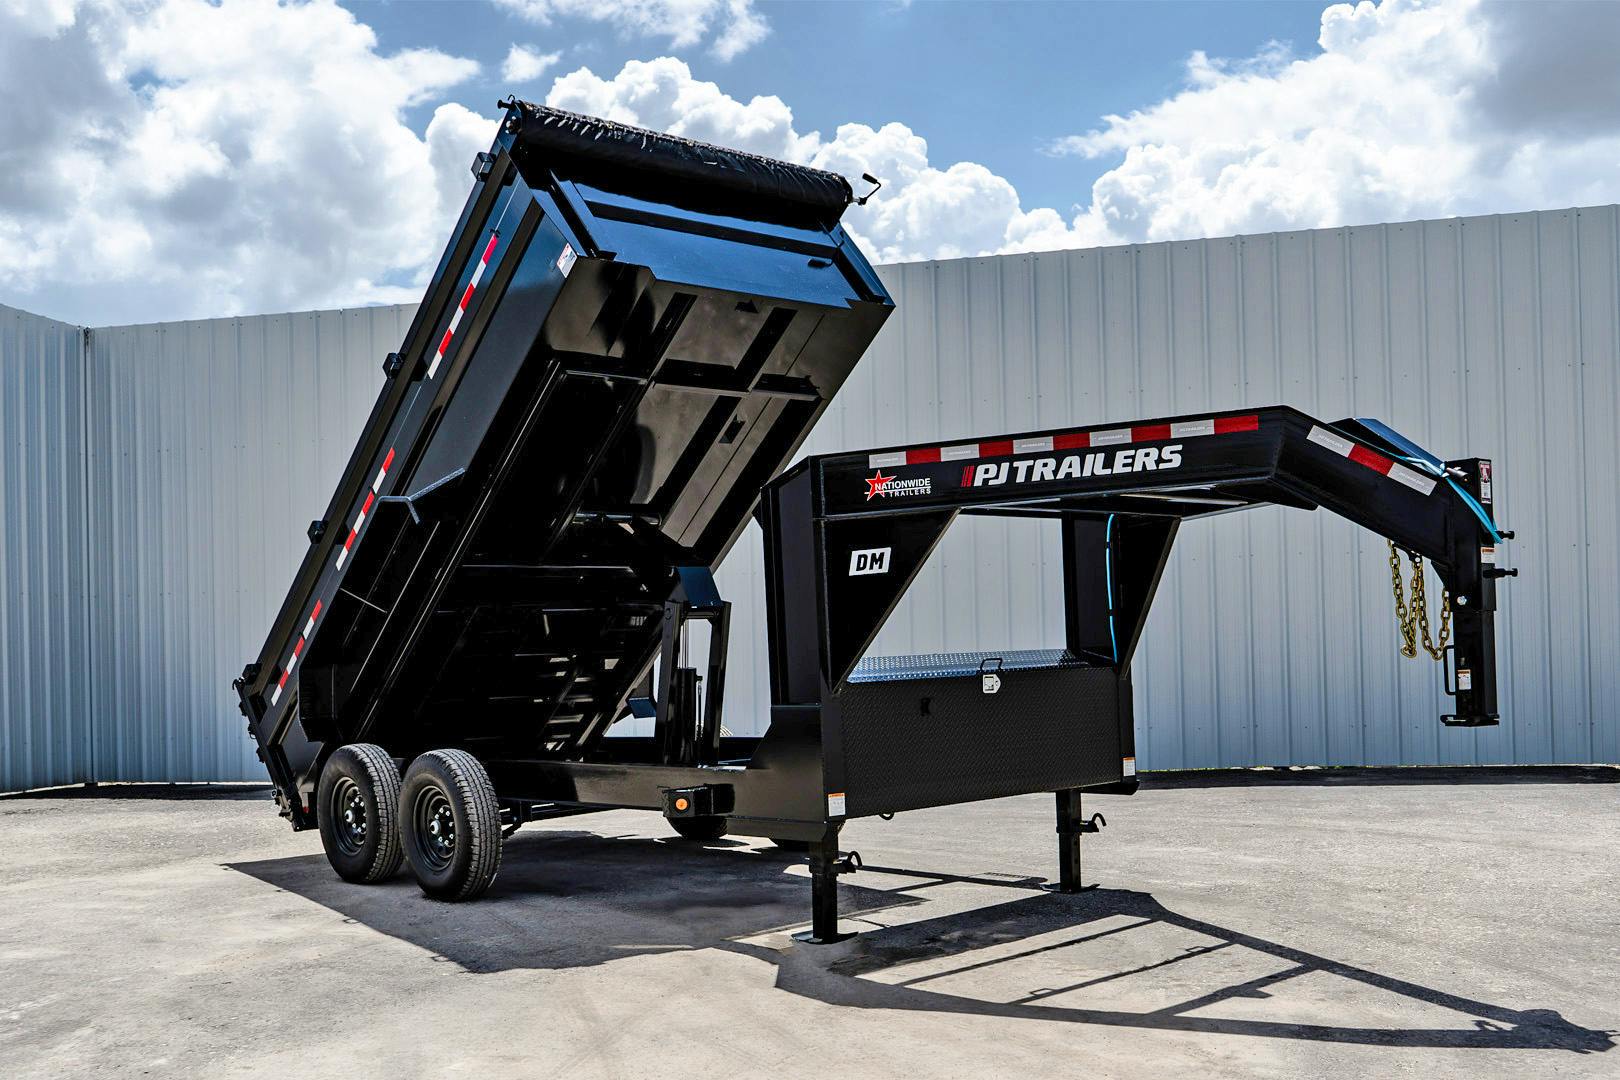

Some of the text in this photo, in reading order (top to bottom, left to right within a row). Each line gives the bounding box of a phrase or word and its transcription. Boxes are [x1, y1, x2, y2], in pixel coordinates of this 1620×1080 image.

[973, 444, 1184, 487] PJ TRAILERS
[874, 478, 931, 491] NATIONWIDE
[889, 488, 931, 498] TRAILERS
[856, 552, 885, 572] DM
